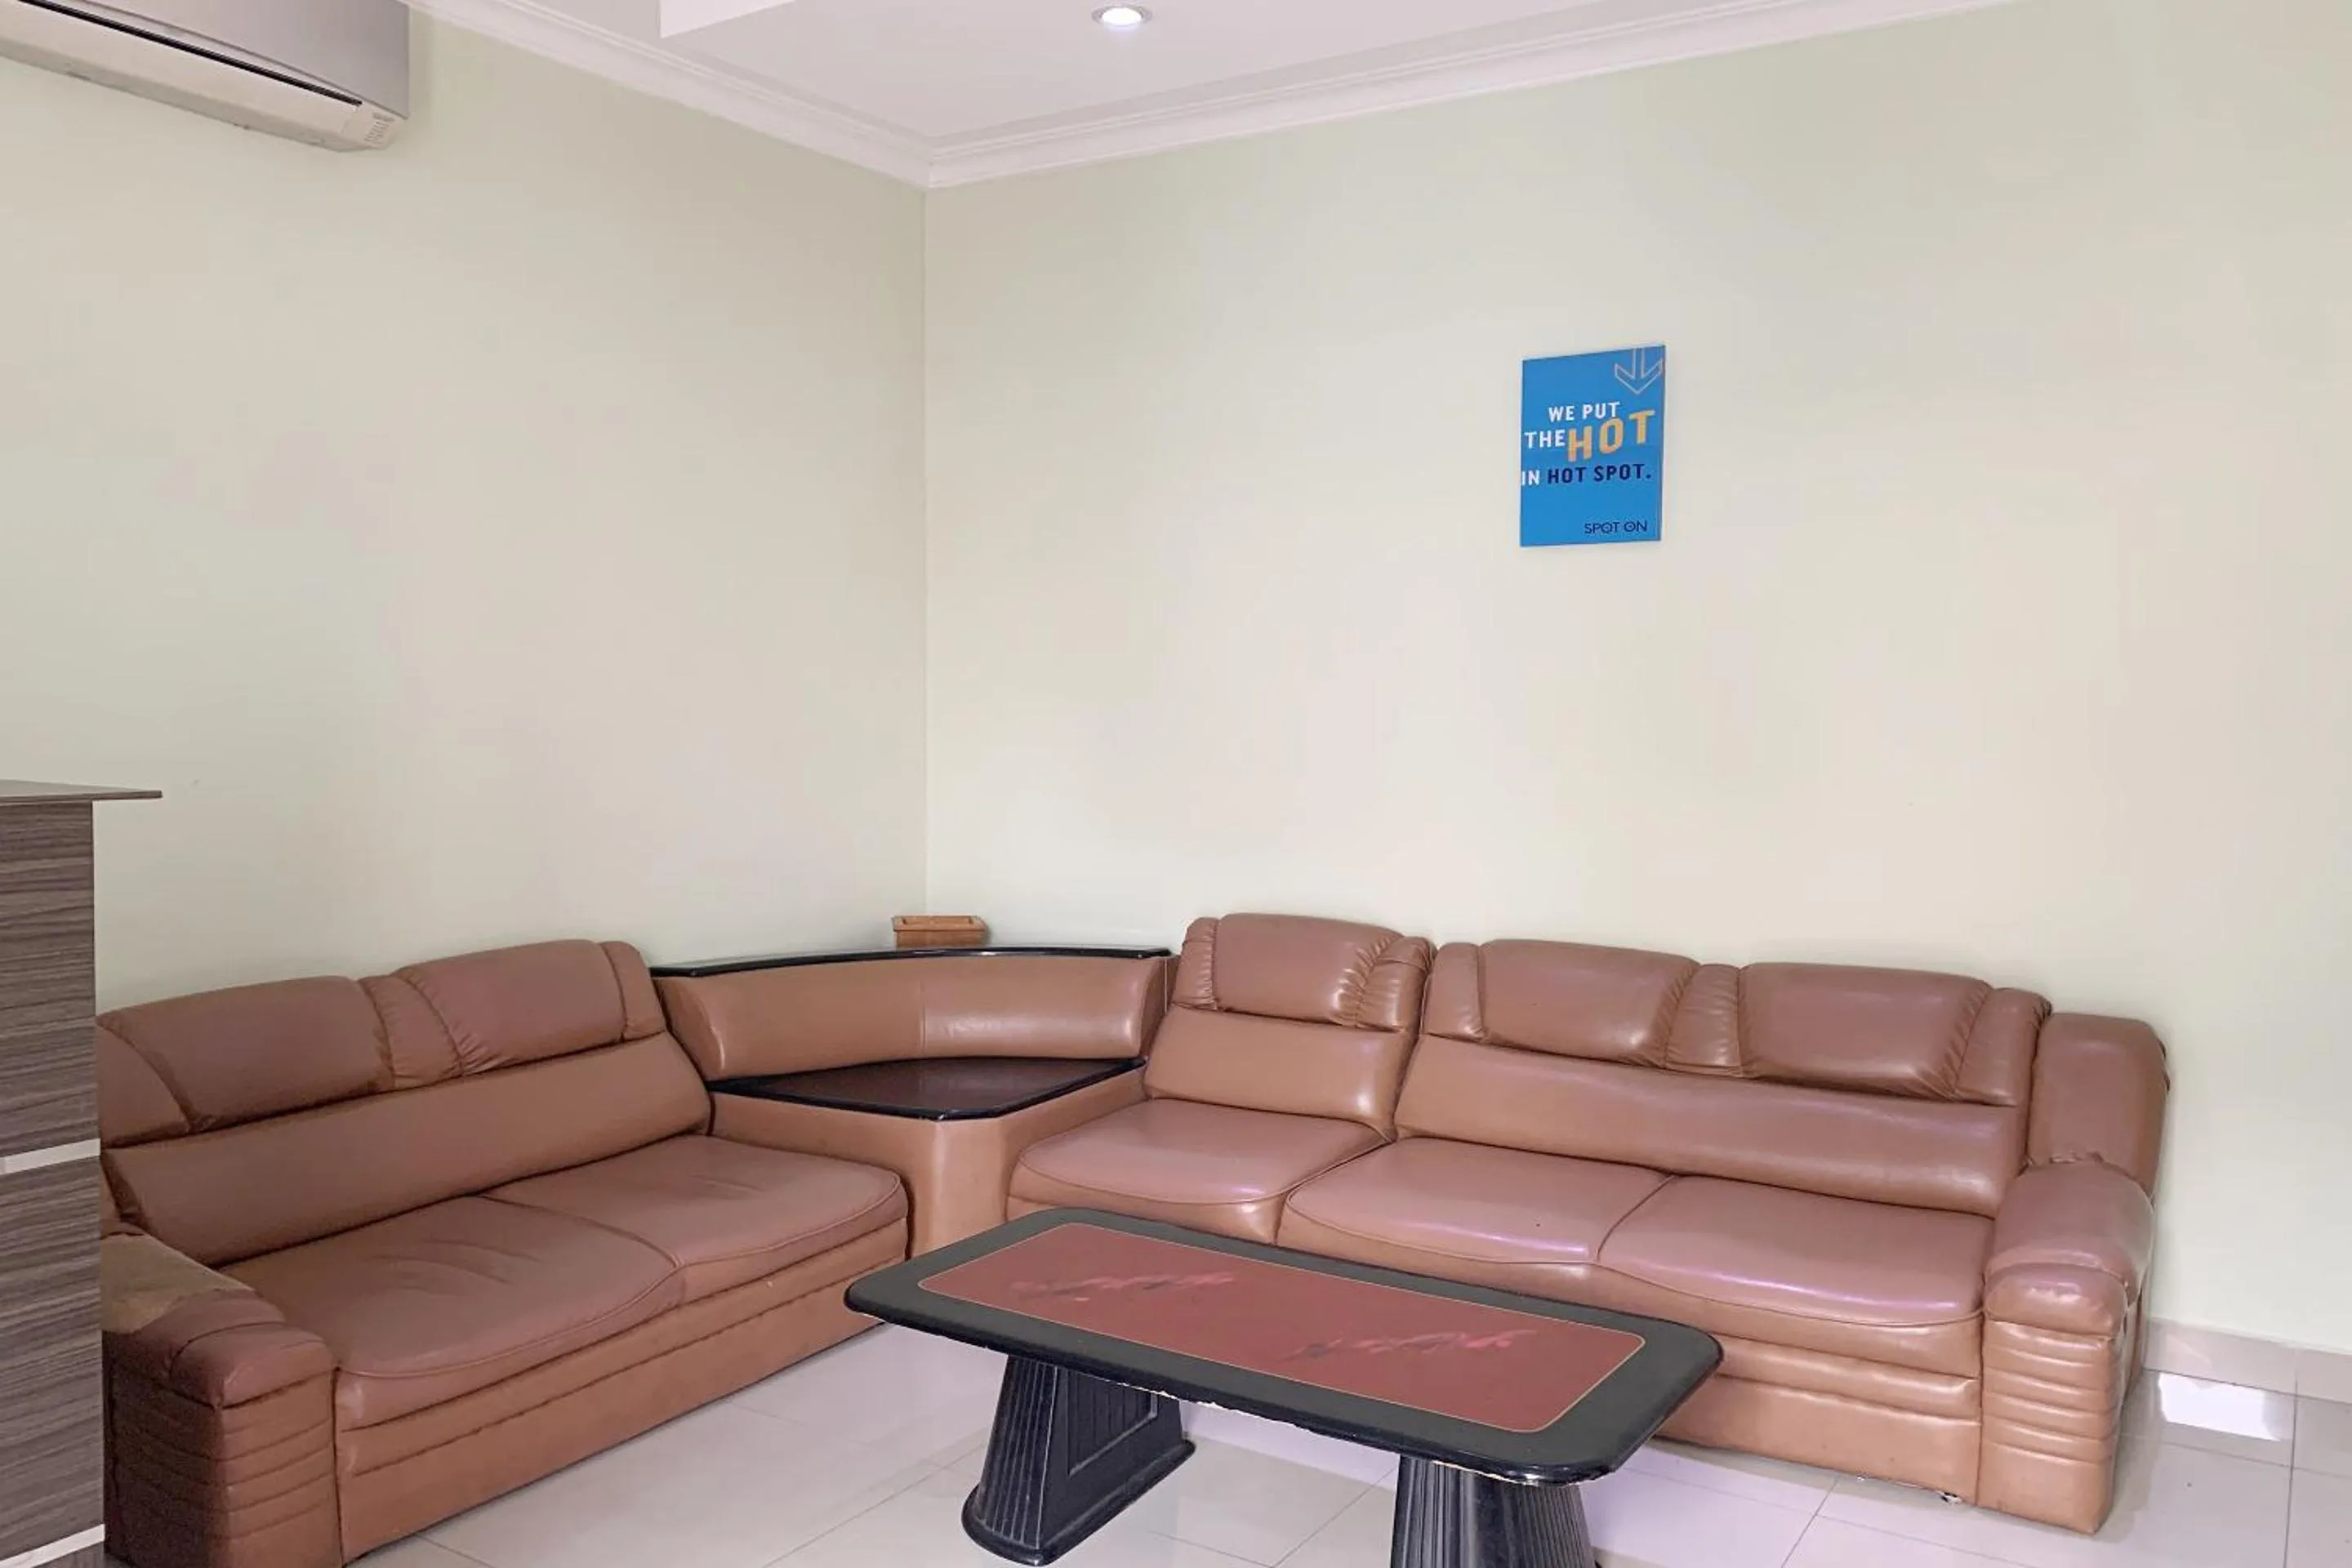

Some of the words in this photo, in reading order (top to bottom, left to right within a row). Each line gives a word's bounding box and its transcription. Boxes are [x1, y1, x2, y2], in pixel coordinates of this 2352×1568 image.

[1548, 405, 1575, 422] WE
[1582, 401, 1620, 420] PUT
[1524, 429, 1566, 449] THE
[1568, 410, 1655, 462] HOT
[1521, 470, 1540, 486] IN
[1548, 466, 1588, 484] HOT
[1593, 463, 1651, 482] SPOT.
[1584, 521, 1620, 534] SPOT
[1624, 519, 1648, 532] ON
